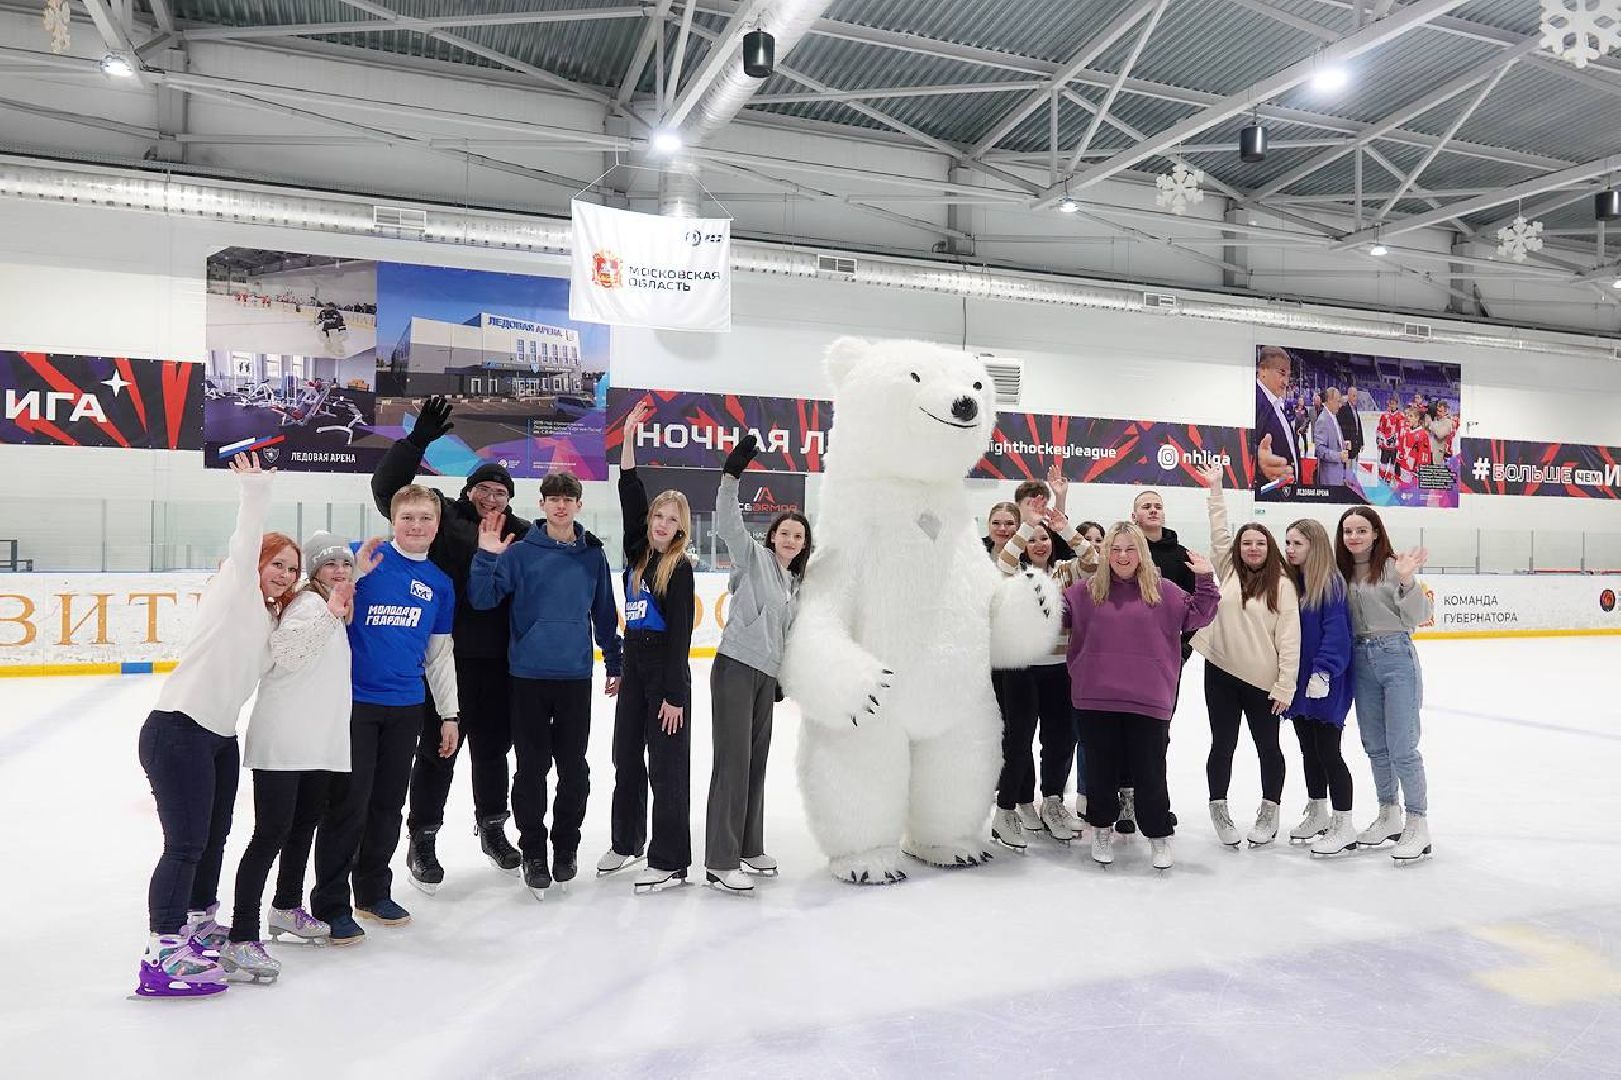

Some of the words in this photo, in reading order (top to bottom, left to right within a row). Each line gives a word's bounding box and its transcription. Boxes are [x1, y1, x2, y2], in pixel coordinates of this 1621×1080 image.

[629, 266, 721, 280] МОСКОВСКАЯ
[628, 278, 691, 292] ОБЛАСТЬ
[291, 452, 329, 463] ЛЕДОВАЯ
[330, 453, 357, 464] АРЕНА
[1471, 457, 1573, 484] #БОЛЬШЕ
[1443, 595, 1499, 606] КОМАНДА
[0, 592, 202, 647] ВИТ
[1443, 612, 1519, 624] ГУБЕРНАТОРА
